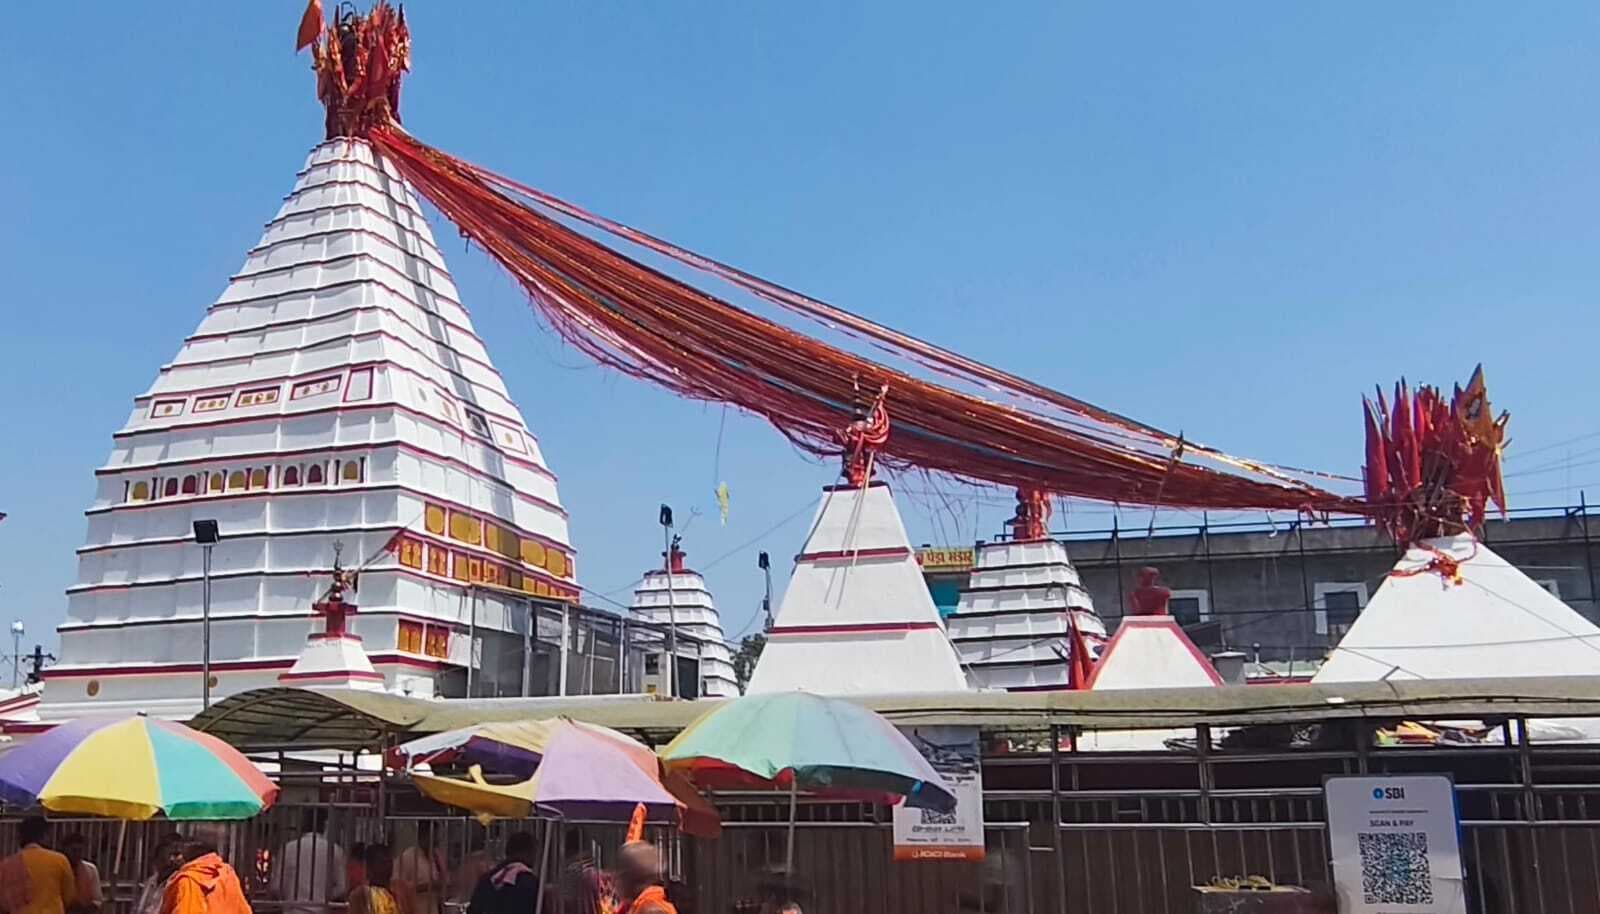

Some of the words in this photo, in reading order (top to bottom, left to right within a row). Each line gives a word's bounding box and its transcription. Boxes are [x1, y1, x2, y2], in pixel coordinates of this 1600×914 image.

[1385, 787, 1405, 799] SBI
[1369, 819, 1391, 827] SCAN
[1392, 819, 1398, 827] &
[1399, 819, 1414, 827] PAY
